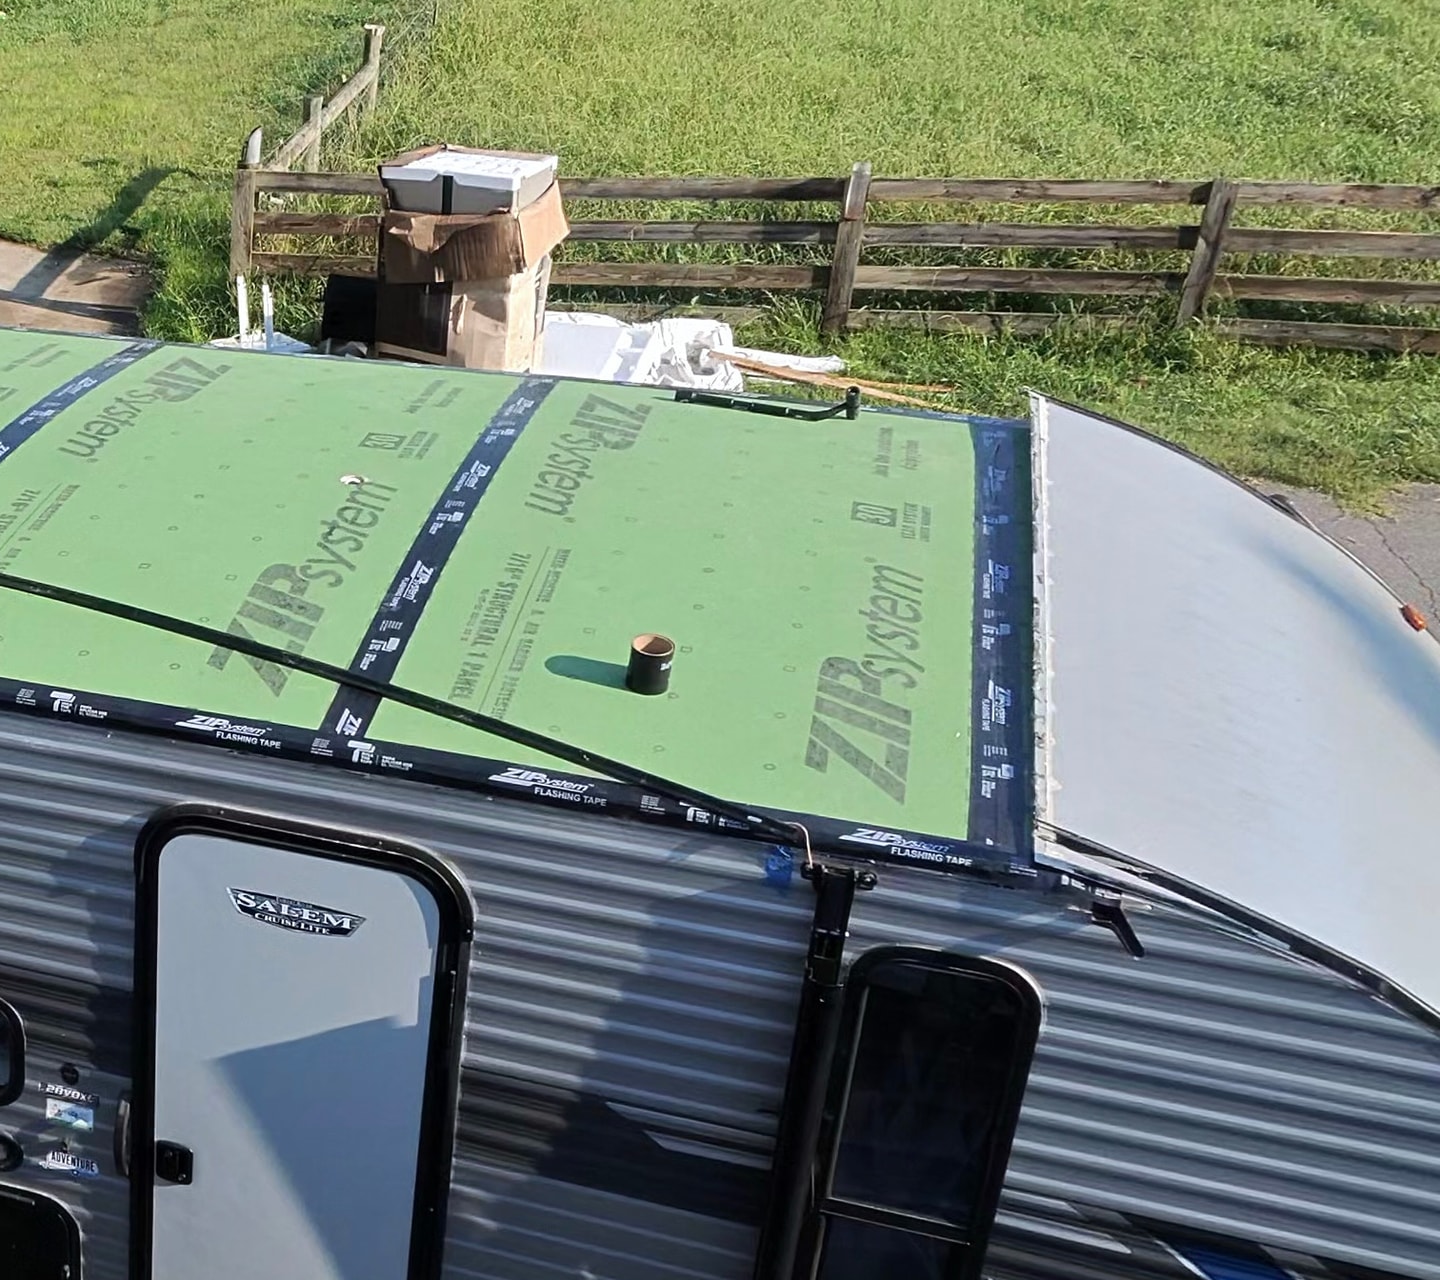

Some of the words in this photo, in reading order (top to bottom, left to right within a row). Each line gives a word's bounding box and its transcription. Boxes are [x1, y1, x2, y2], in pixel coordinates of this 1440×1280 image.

[216, 731, 258, 745] FLASHING
[259, 738, 282, 750] TAPE
[534, 786, 581, 803] FLASHING
[583, 795, 608, 808] TAPE
[891, 846, 943, 863] FLASHING
[945, 854, 973, 869] TAPE
[236, 892, 353, 930] SALEM
[51, 1151, 96, 1173] ADVENTURE
